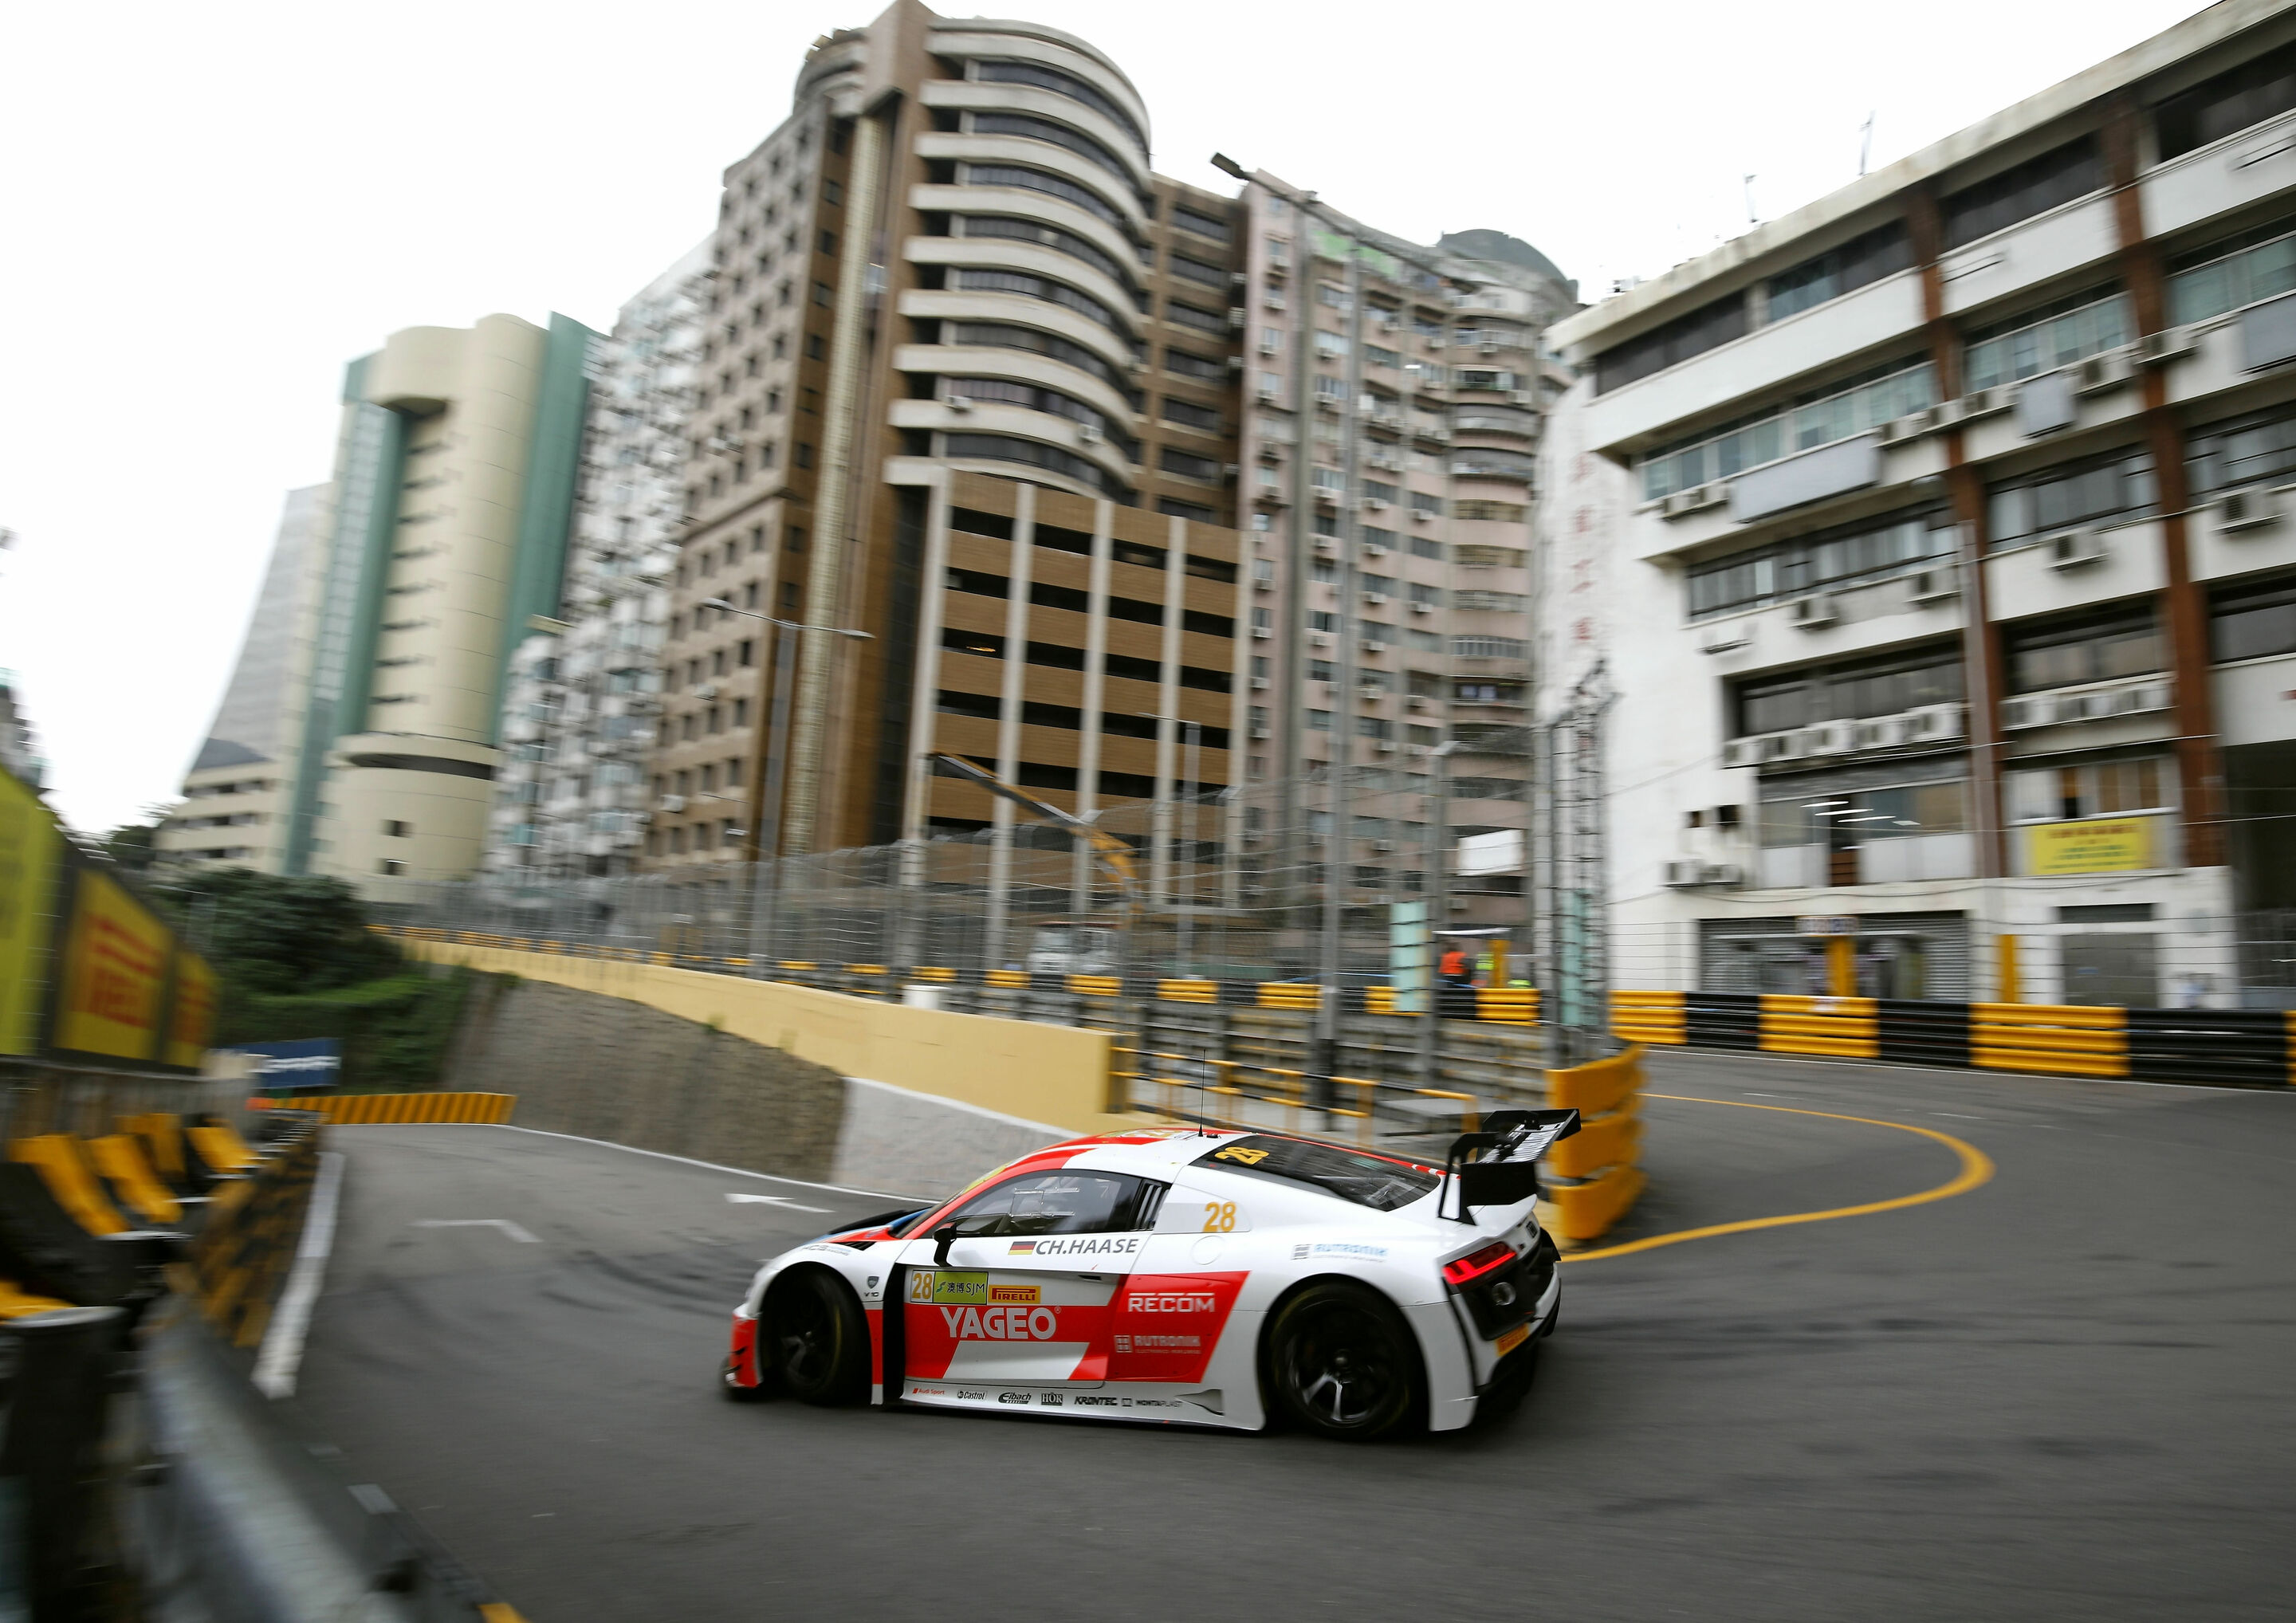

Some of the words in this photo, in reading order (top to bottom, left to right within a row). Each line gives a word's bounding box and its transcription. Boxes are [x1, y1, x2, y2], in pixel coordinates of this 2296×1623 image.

[1202, 1201, 1236, 1233] 28
[1036, 1238, 1138, 1256] CH.HAASE
[912, 1273, 933, 1299] 28
[966, 1283, 985, 1296] SJM
[991, 1287, 1036, 1301] PIRELLI
[1128, 1297, 1215, 1313] RECOM
[940, 1307, 1057, 1340] YAGEO
[963, 1391, 985, 1400] Castrol
[998, 1392, 1032, 1404] Eibach
